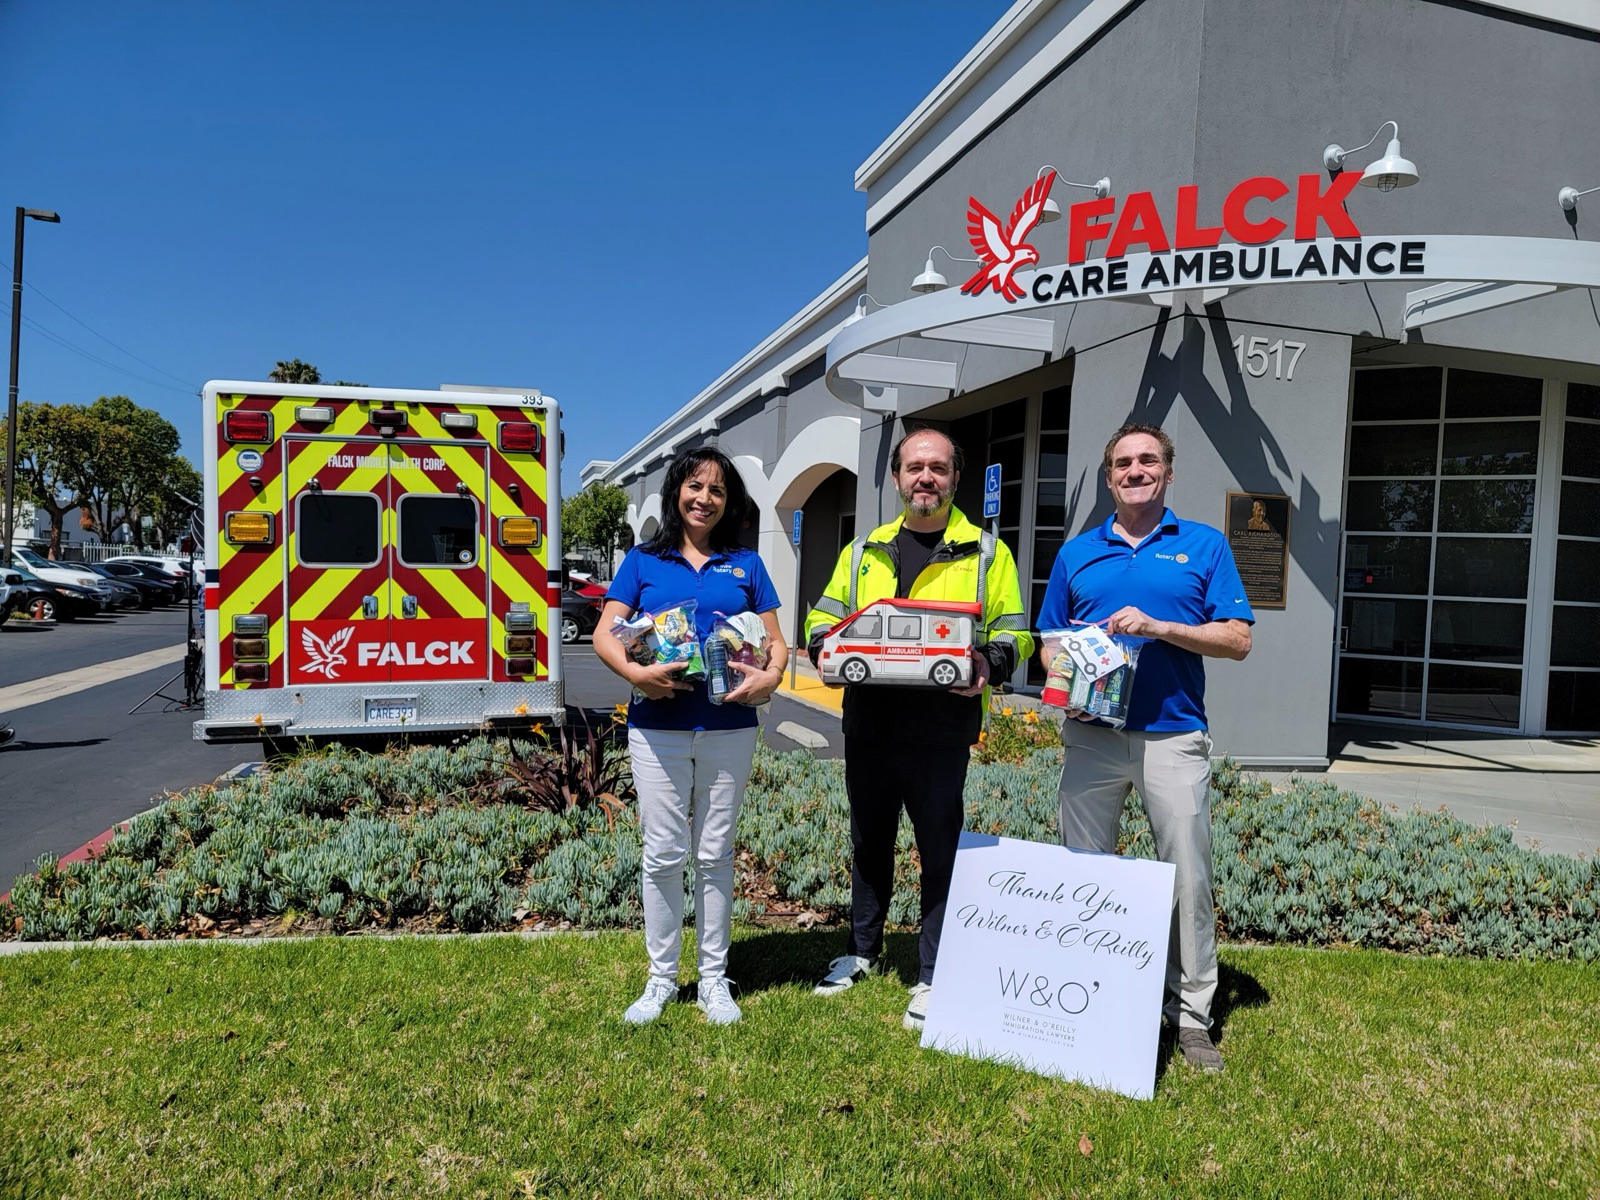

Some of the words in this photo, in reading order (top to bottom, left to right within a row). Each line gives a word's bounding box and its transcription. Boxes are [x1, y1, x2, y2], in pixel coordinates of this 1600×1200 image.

[1068, 172, 1366, 264] FALCK
[1031, 261, 1129, 301] CARE
[1141, 241, 1426, 290] AMBULANCE
[1232, 335, 1306, 380] 1517
[521, 395, 543, 406] 393
[327, 455, 354, 468] FALCK
[356, 456, 388, 469] MOBILE
[423, 458, 447, 471] CORP.
[1248, 530, 1282, 539] RICHARDSON
[1155, 553, 1175, 561] Rotary
[713, 566, 732, 574] Rotary
[358, 640, 476, 667] FALCK
[370, 707, 413, 720] CARE393
[988, 870, 1065, 904] Thank
[1072, 882, 1129, 922] You
[956, 904, 1028, 937] Wilner
[1035, 920, 1054, 939] &
[1057, 923, 1155, 970] O'Reilly
[1002, 1020, 1044, 1035] IMMIGRATION
[1046, 1031, 1075, 1042] LAWYERS
[1003, 1012, 1031, 1024] WILNER
[1042, 1021, 1077, 1034] O'REILLY
